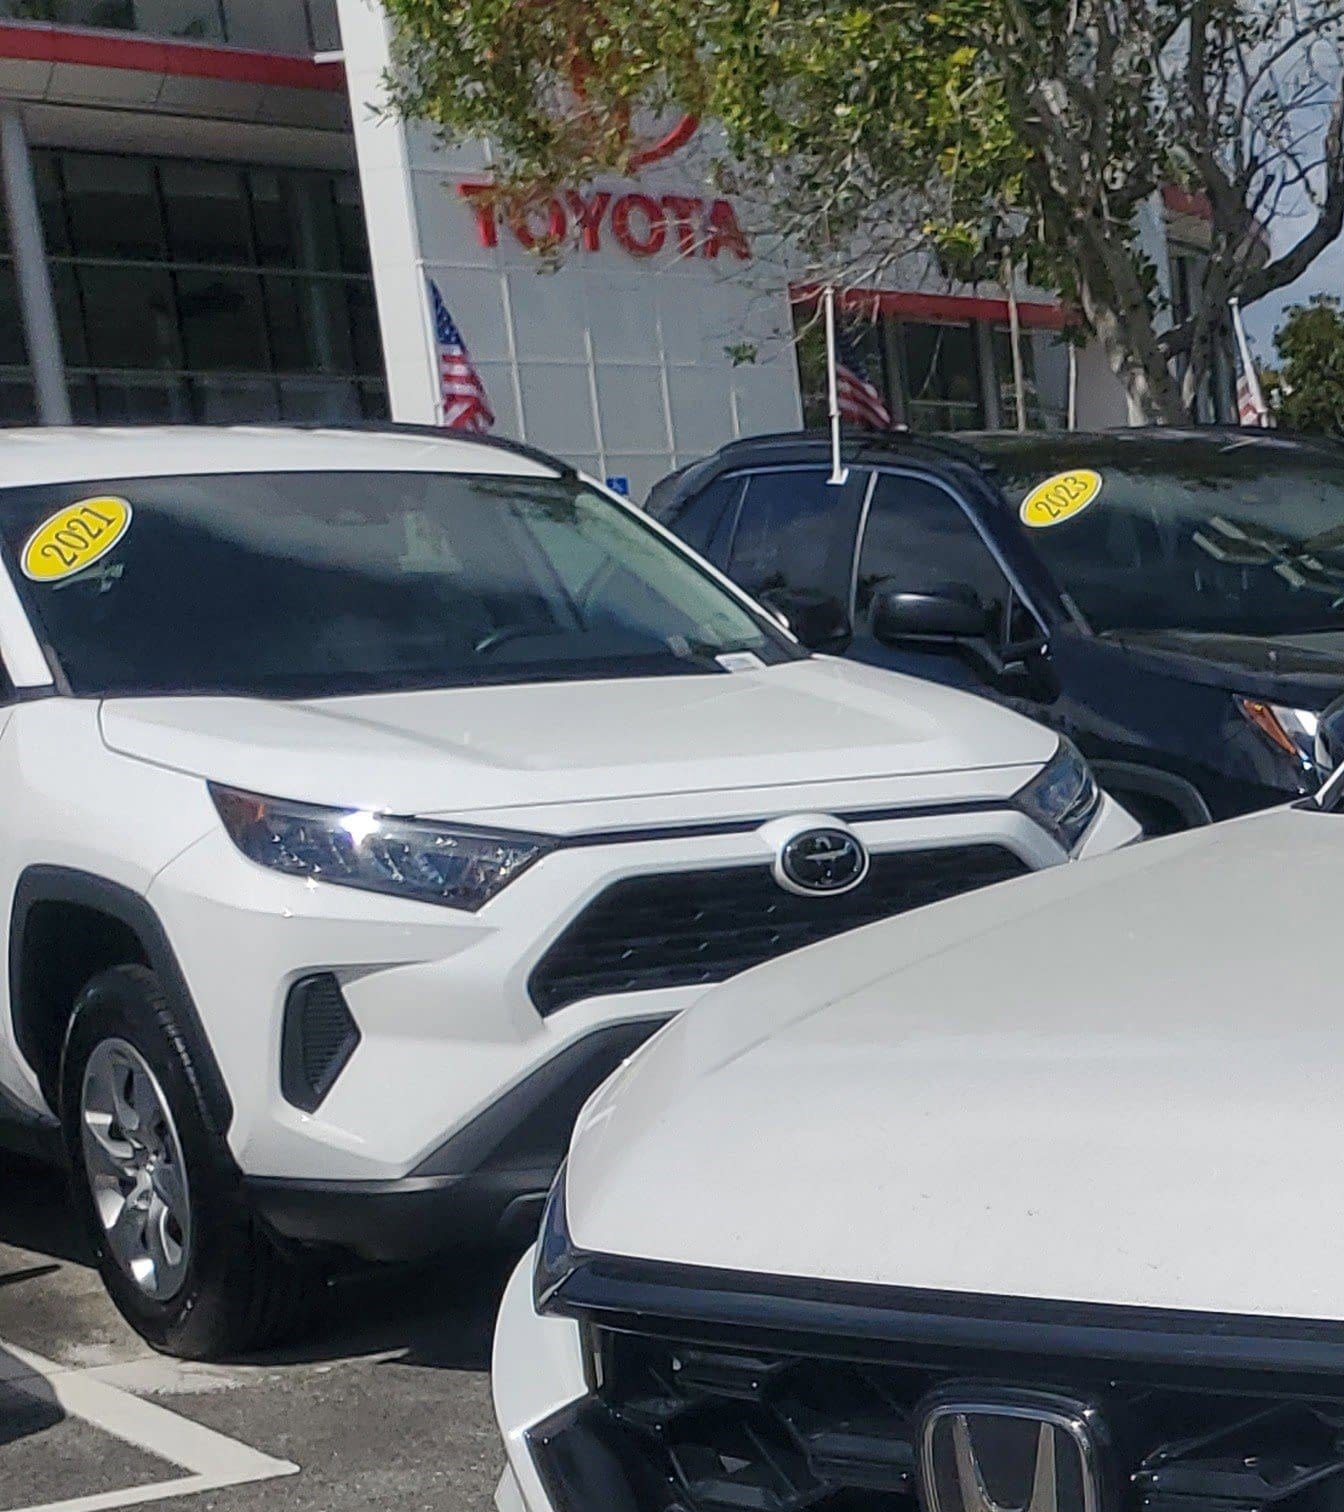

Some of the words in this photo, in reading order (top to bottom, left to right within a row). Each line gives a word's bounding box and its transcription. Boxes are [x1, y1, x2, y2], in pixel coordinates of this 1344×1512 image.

[456, 182, 751, 260] TOYOTA
[1035, 476, 1088, 518] 2023
[41, 507, 116, 567] 2021
